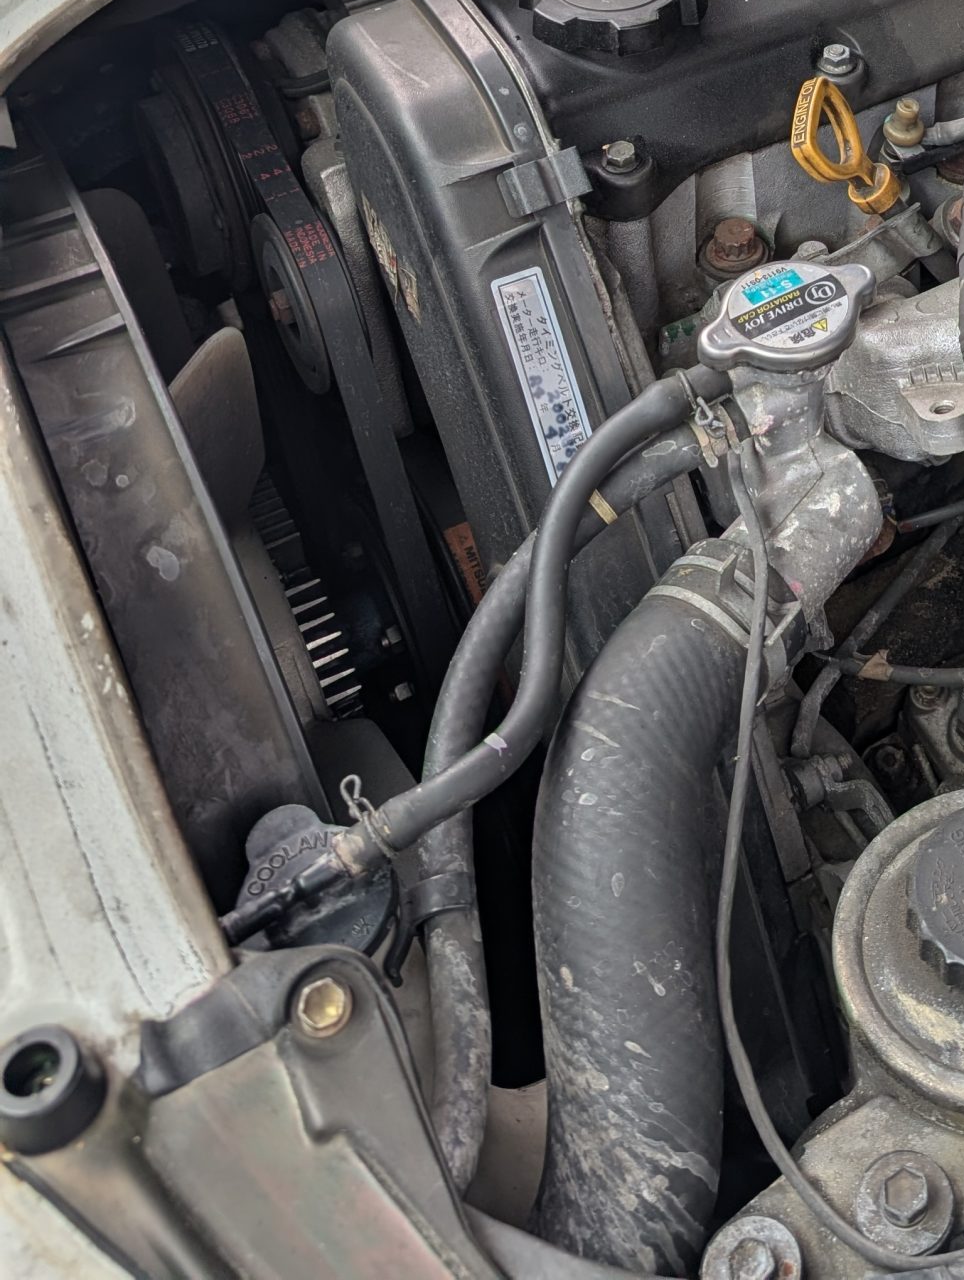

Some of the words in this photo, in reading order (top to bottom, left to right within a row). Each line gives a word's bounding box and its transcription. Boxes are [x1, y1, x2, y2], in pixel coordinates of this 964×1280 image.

[793, 94, 812, 145] ENGINE
[756, 290, 800, 313] RADIATOR
[767, 299, 803, 320] DRIVE
[737, 311, 755, 323] CAP
[744, 315, 765, 331] JOY
